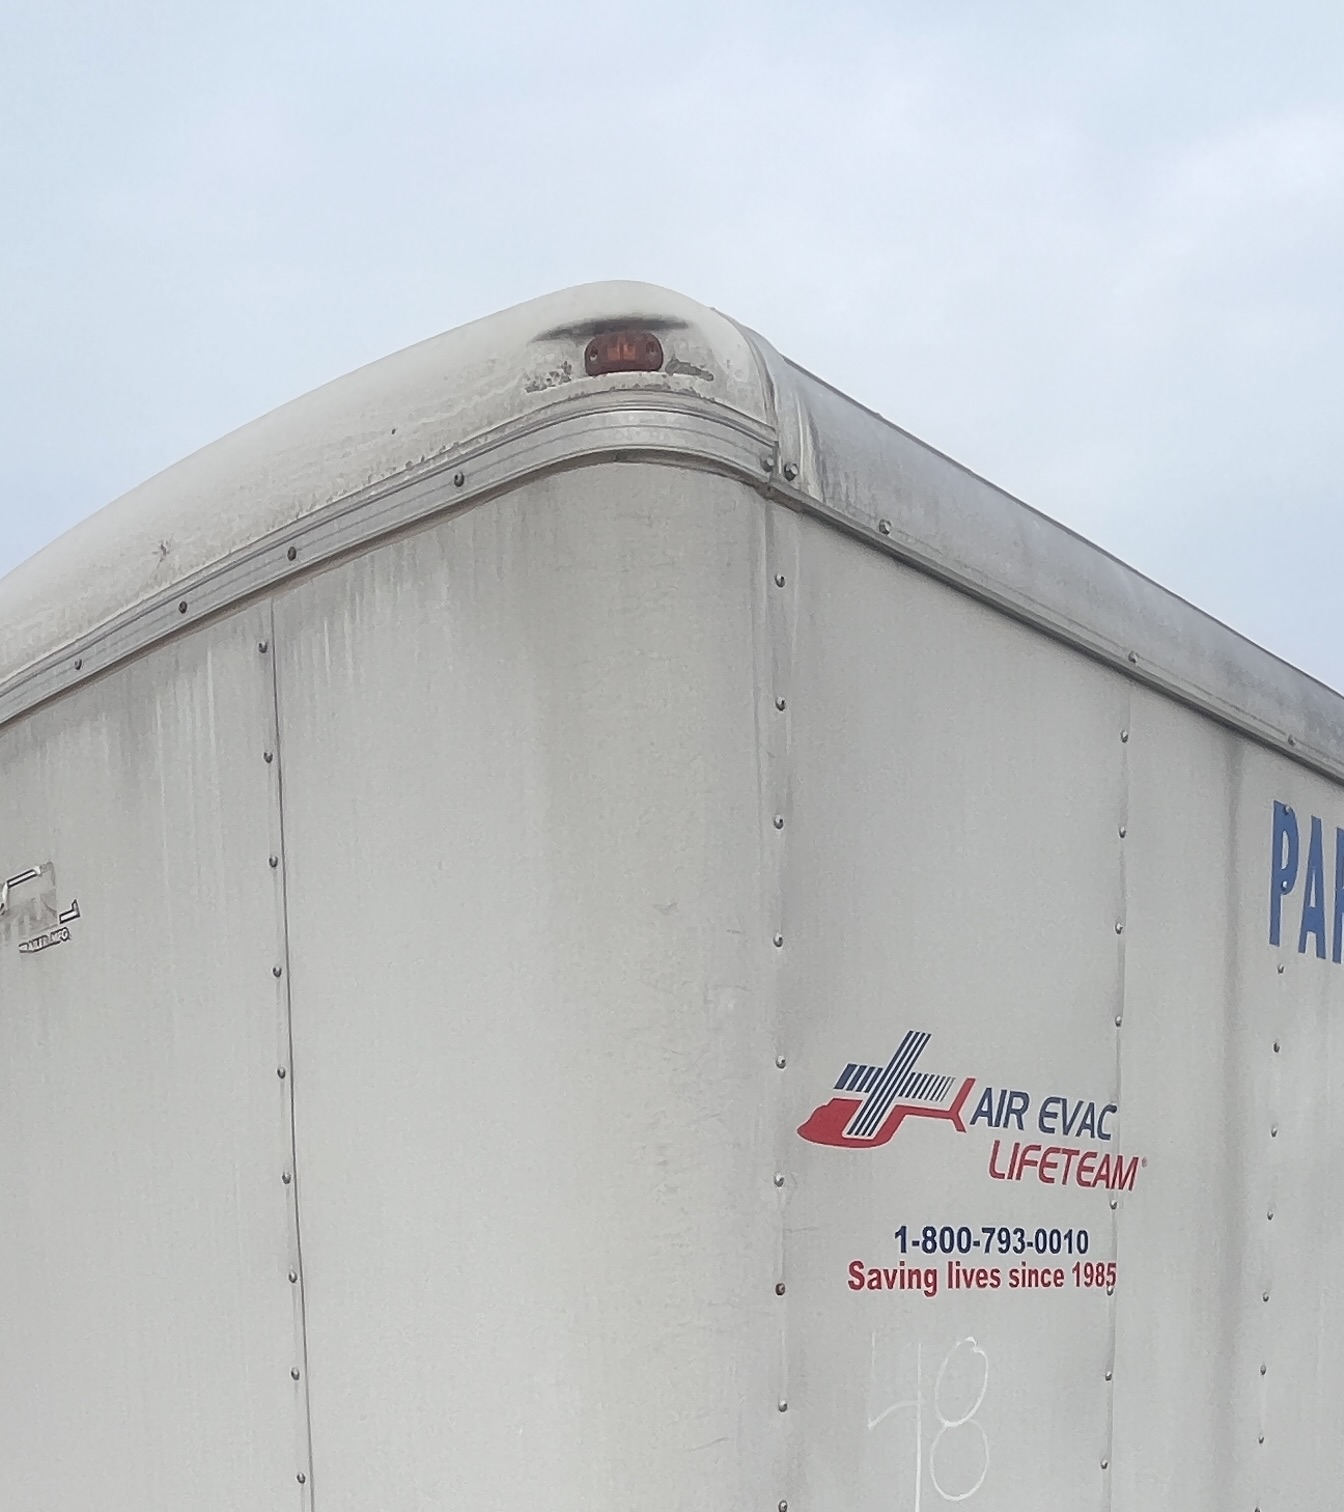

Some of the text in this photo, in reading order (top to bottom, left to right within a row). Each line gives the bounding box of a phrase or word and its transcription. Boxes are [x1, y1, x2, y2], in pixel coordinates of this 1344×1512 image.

[969, 1086, 1118, 1142] AIR EVAC
[893, 1224, 1090, 1256] 1-800-793-0010
[847, 1259, 1118, 1299] Saving lives since 1985
